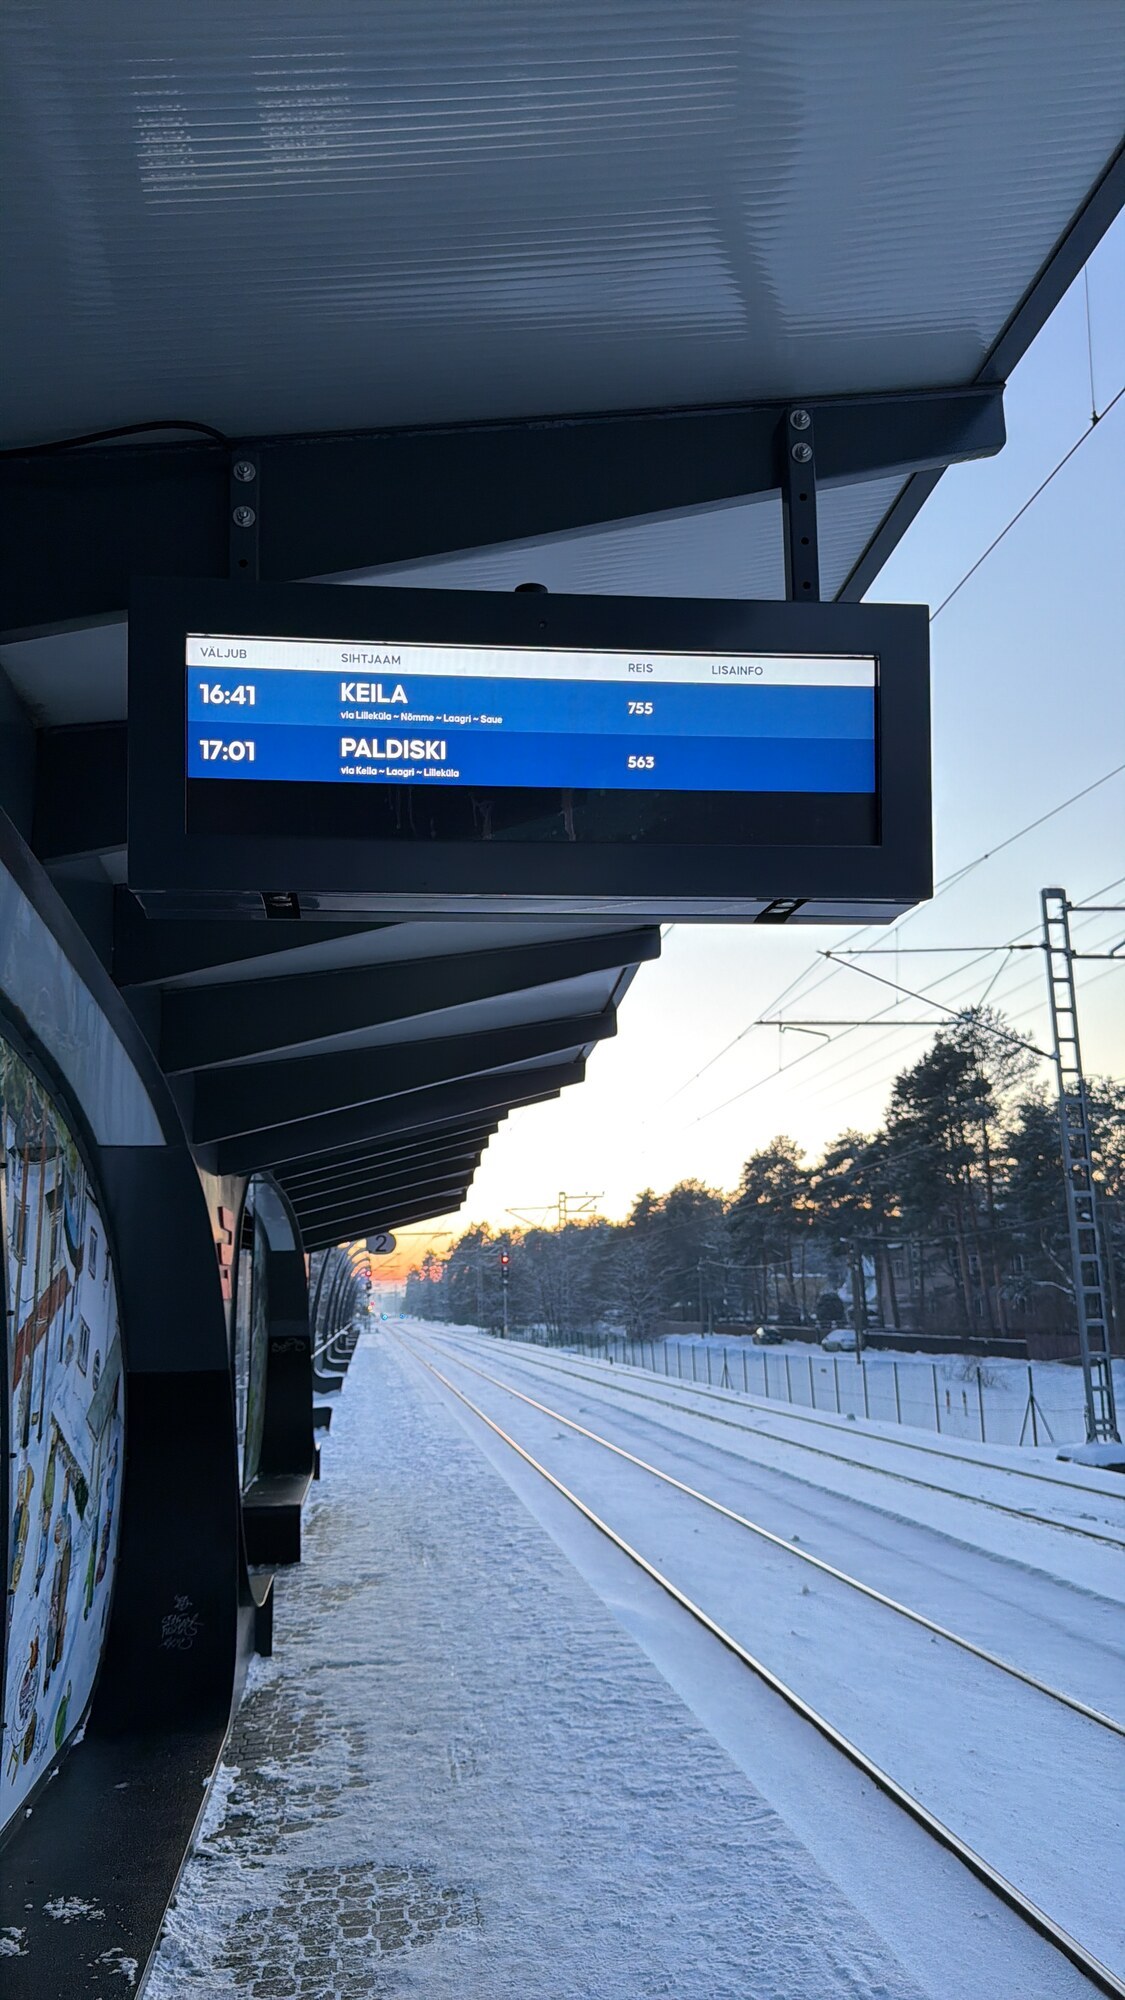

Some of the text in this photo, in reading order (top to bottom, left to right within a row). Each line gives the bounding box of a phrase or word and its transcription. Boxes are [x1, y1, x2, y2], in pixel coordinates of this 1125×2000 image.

[200, 646, 247, 659] VÄLJUB
[341, 653, 401, 665] SIHTJAAM
[628, 663, 654, 673] REIS
[711, 665, 764, 676] LISAINFO
[199, 684, 256, 706] 16:41
[341, 683, 408, 704] KEILA
[627, 702, 654, 715] 755
[340, 710, 355, 720] via
[356, 711, 392, 721] Lilleküla
[443, 713, 472, 725] Laagri
[480, 714, 503, 724] Saue
[199, 740, 255, 762] 17:01
[341, 737, 447, 760] PALDISKI
[627, 755, 655, 769] 563
[340, 766, 355, 775] via
[356, 766, 378, 776] Keila
[386, 767, 415, 778] Laagri
[423, 768, 460, 778] Lilleküla
[375, 1235, 388, 1251] 2
